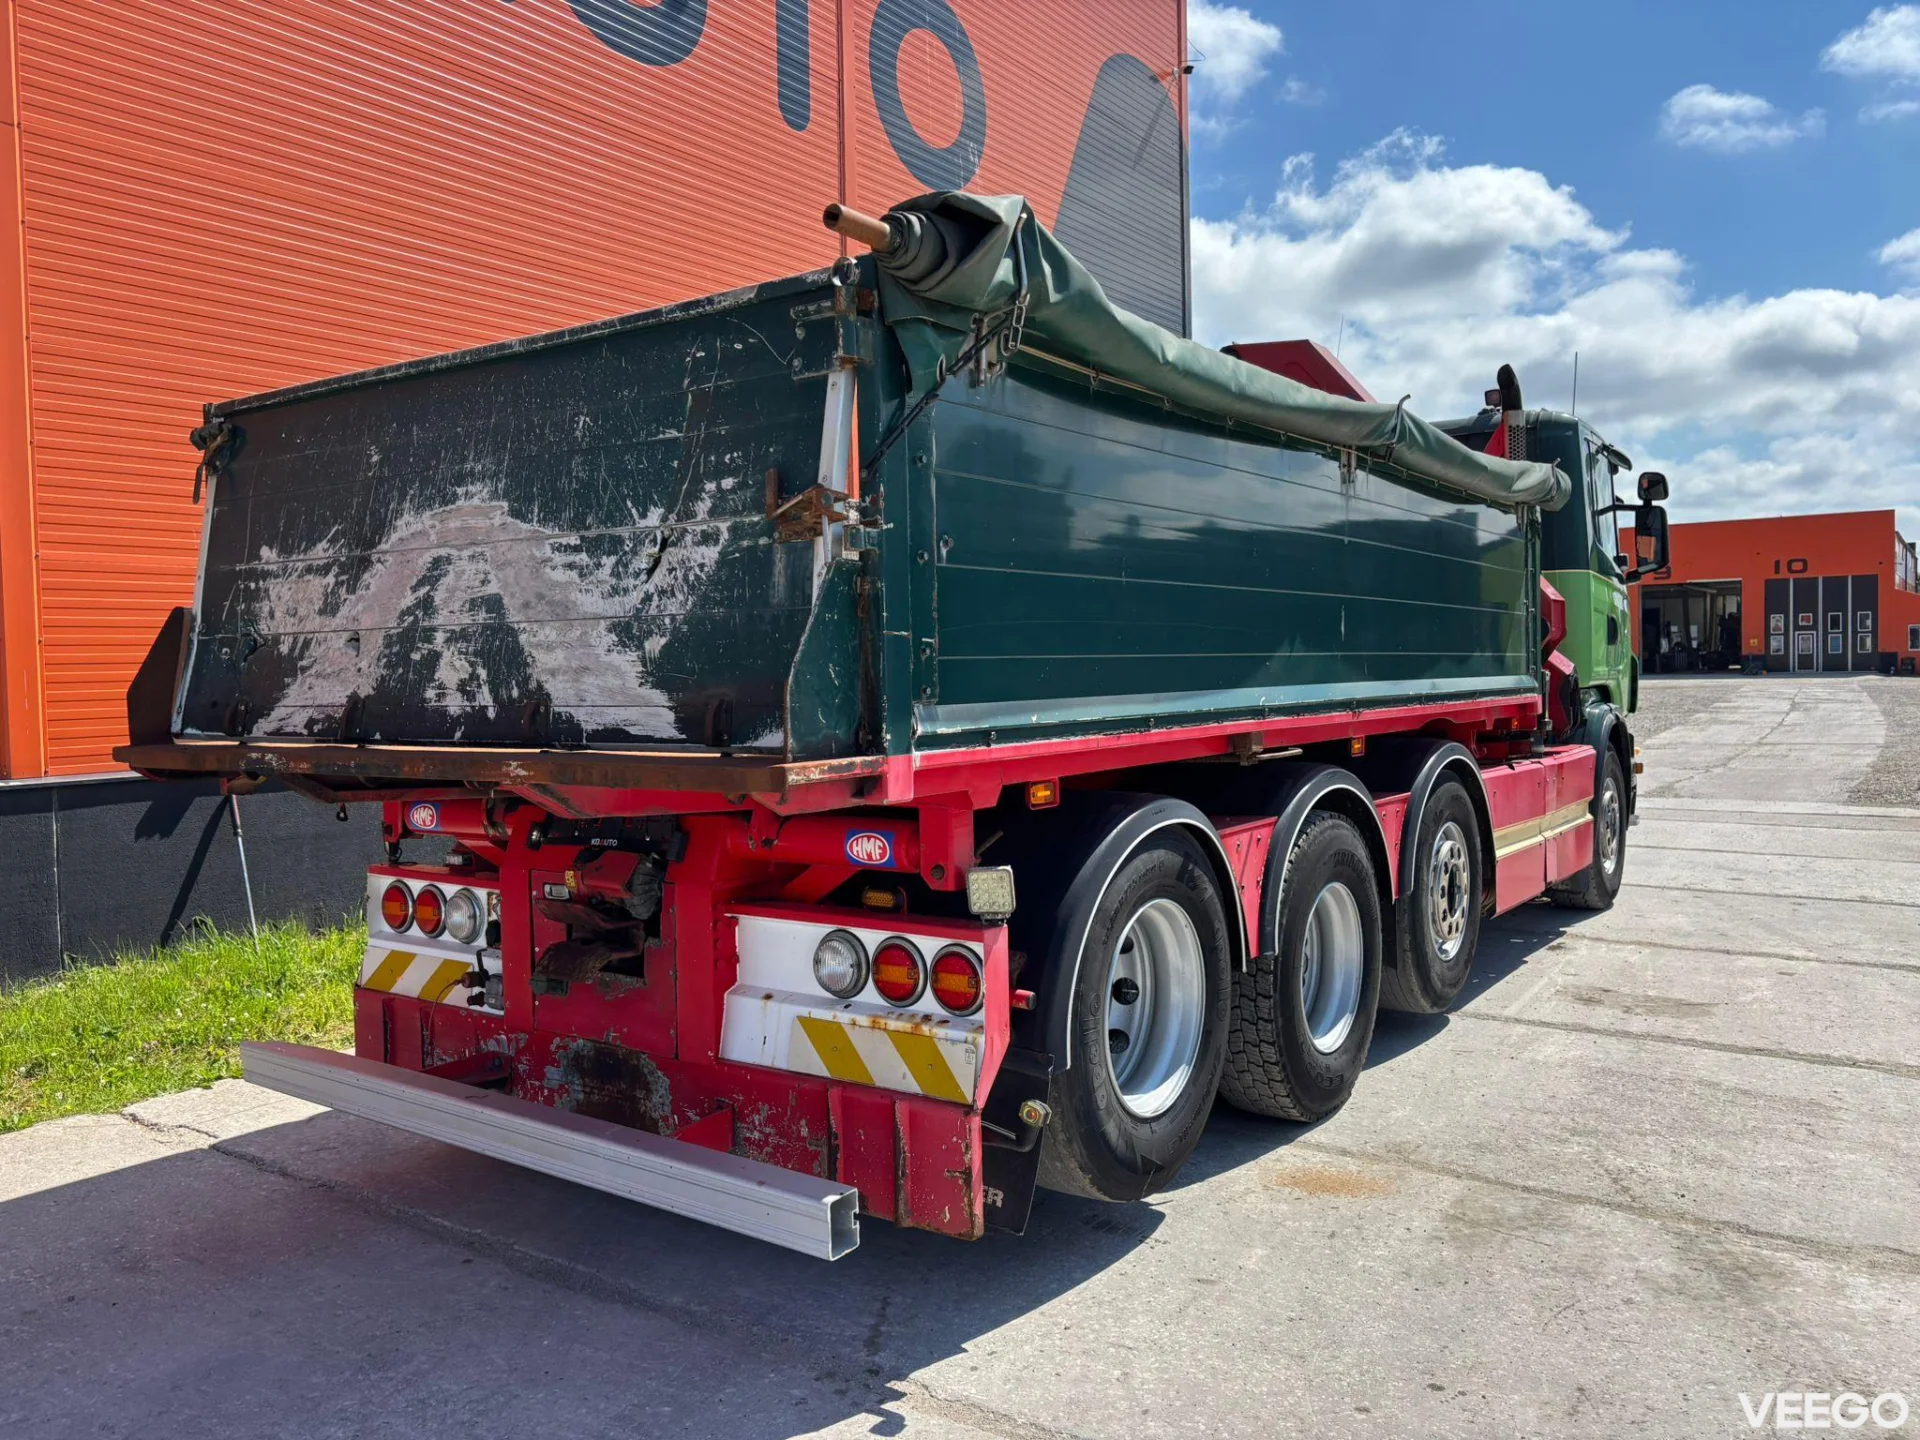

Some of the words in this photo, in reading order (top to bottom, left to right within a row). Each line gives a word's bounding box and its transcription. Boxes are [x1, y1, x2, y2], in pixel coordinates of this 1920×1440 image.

[1774, 558, 1808, 575] 10
[413, 806, 434, 826] HMF
[852, 836, 884, 861] HMF
[1080, 991, 1108, 1111] apollo
